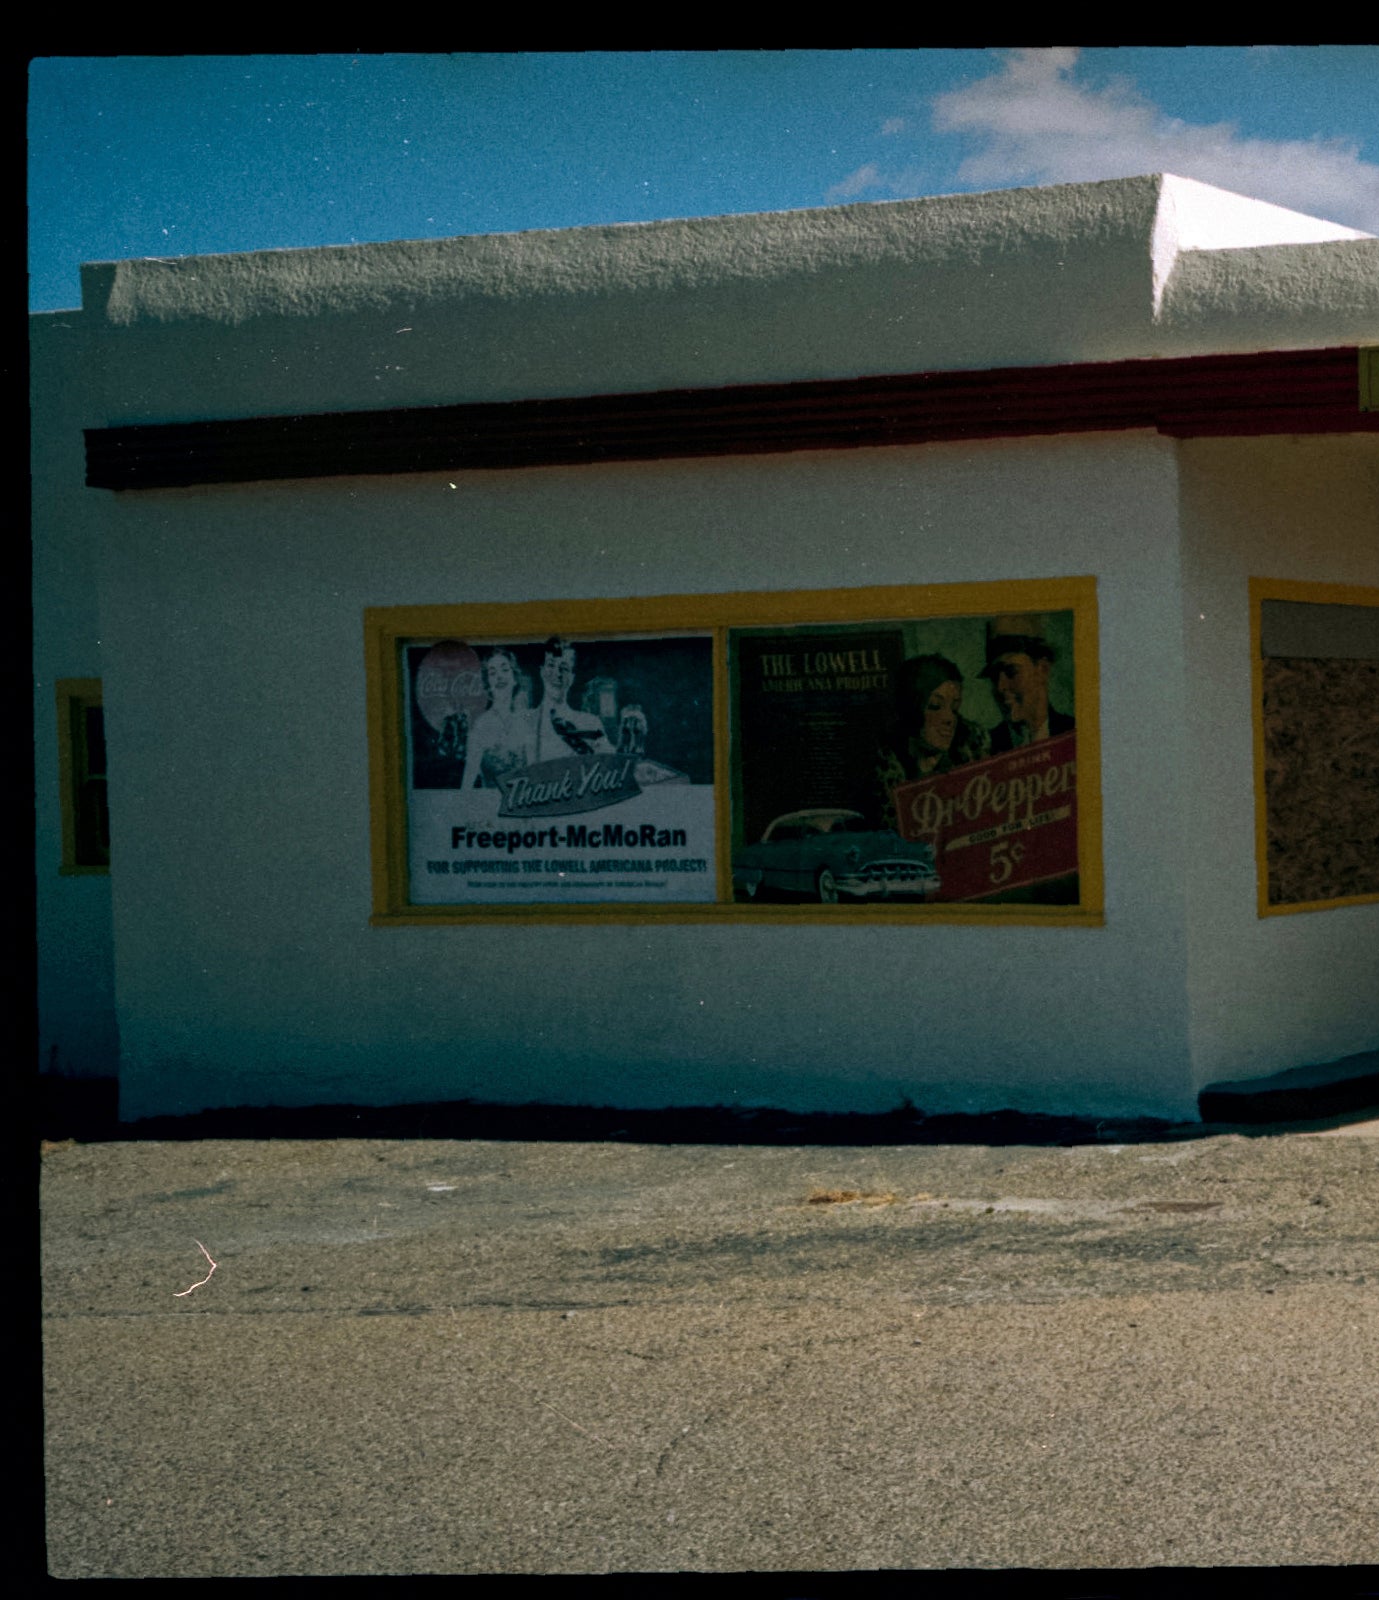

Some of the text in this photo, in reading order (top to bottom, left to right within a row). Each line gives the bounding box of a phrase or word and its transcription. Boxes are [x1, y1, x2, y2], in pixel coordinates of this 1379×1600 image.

[760, 649, 888, 676] THE LOWELL
[836, 673, 889, 691] PROJECT
[506, 759, 630, 811] Thank You!
[961, 762, 1077, 827] Pepper
[452, 825, 687, 853] Freeport-McMoRan
[969, 830, 997, 843] GOOD
[1002, 820, 1022, 833] FOR
[427, 859, 707, 874] FOR SUPPORTING THE LOWELL AMERICANA PROJECT!
